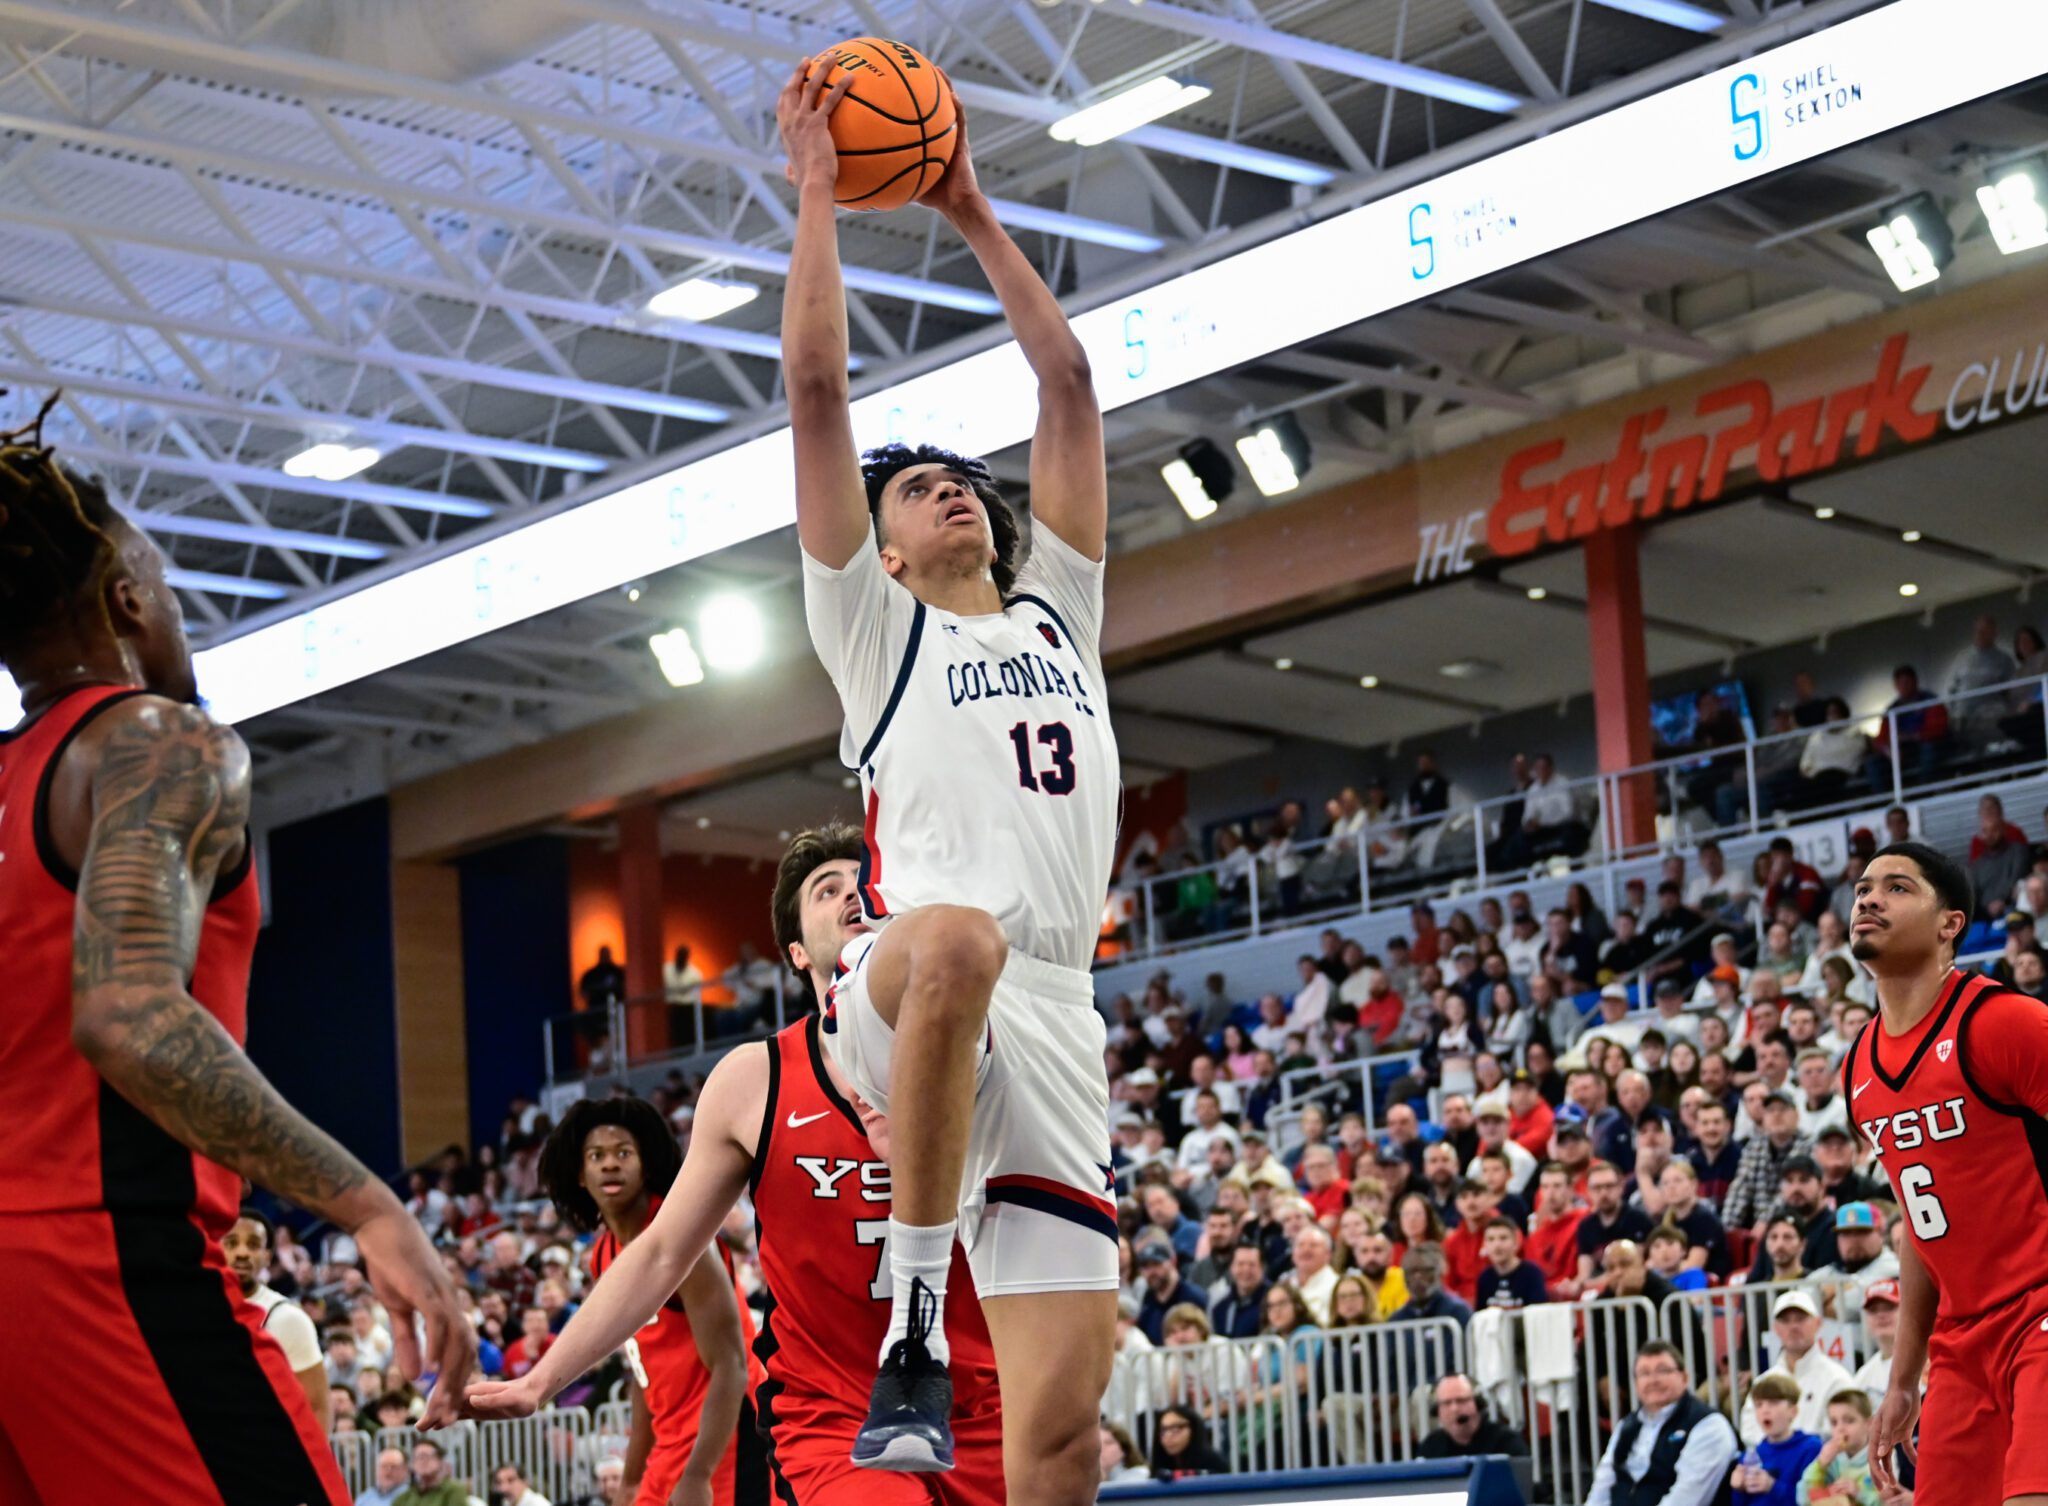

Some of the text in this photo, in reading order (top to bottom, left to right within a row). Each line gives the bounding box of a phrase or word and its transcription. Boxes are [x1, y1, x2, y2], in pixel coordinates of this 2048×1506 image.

[1782, 64, 1838, 100] SHIEL
[1784, 83, 1862, 128] SEXTON
[1414, 511, 1486, 584] THE
[1008, 720, 1076, 796] 13
[1860, 1097, 1967, 1157] YSU
[795, 1156, 892, 1201] YS
[1899, 1163, 1949, 1241] 6
[855, 1218, 893, 1300] 7
